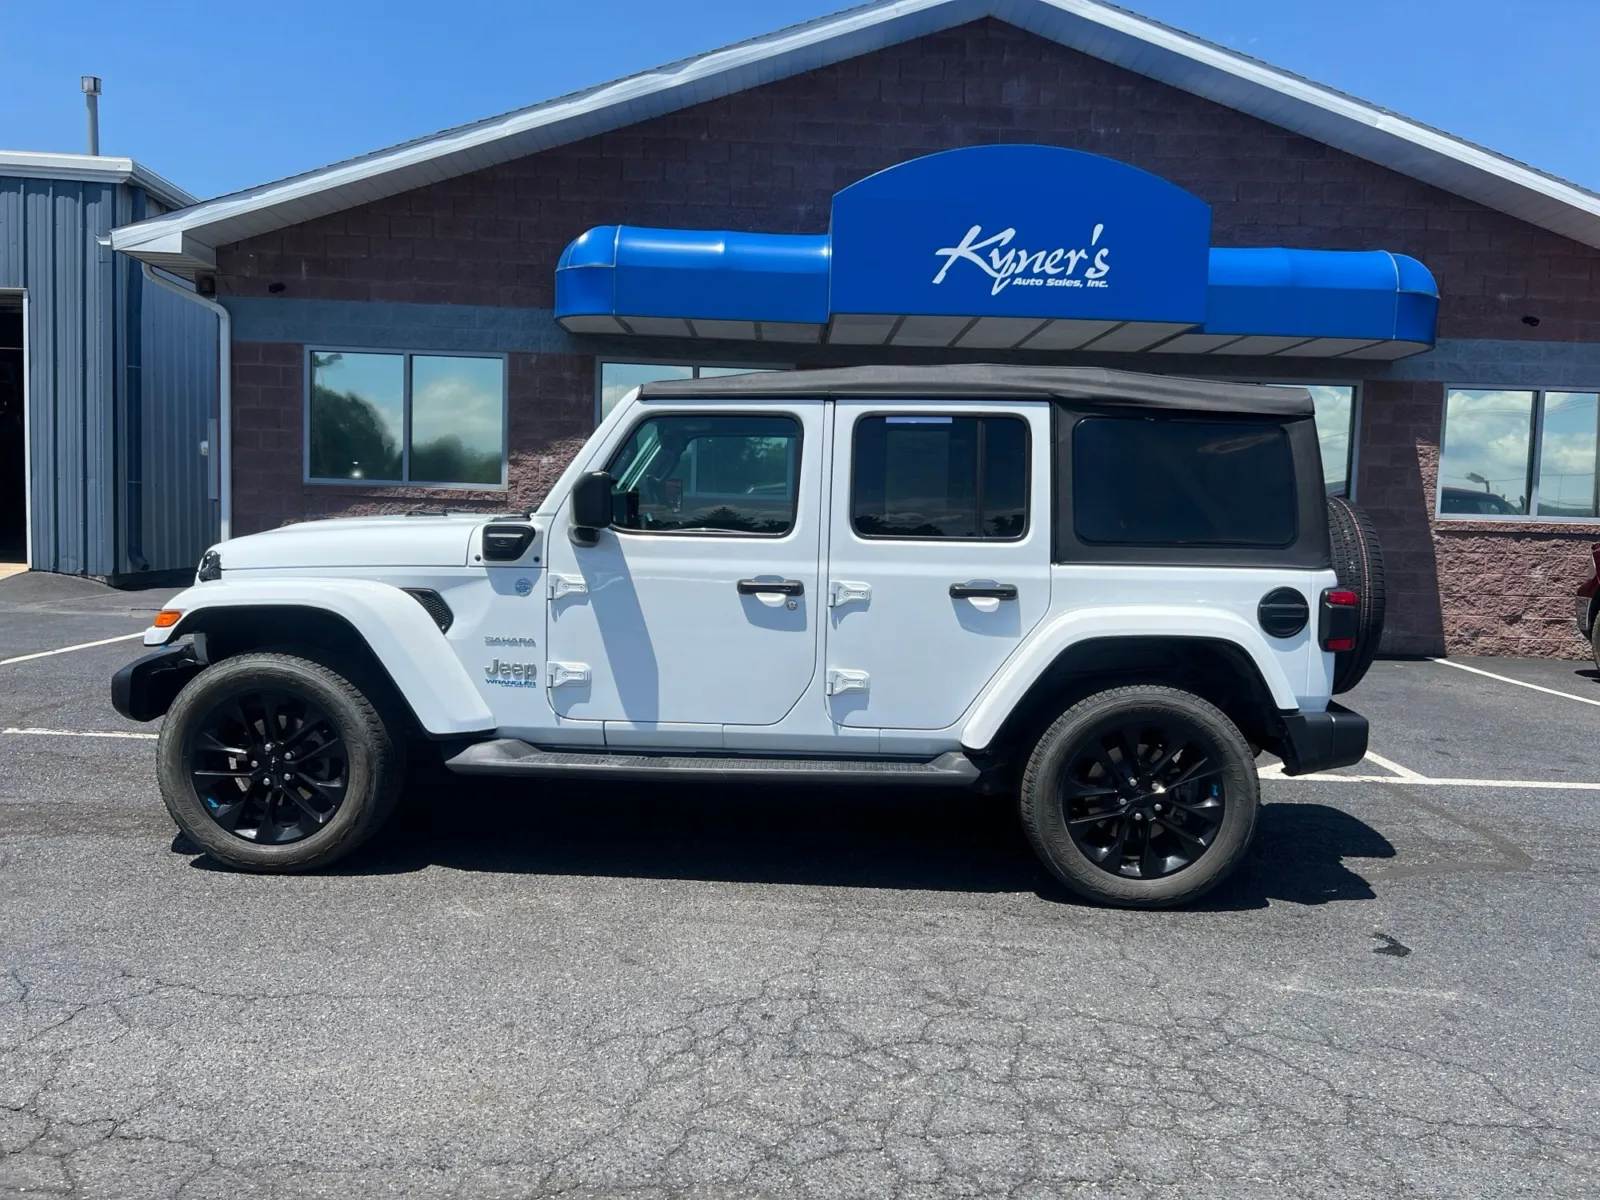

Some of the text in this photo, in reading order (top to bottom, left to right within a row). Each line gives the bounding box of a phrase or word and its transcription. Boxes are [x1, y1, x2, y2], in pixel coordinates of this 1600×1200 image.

[932, 223, 1110, 296] Kyner's
[1011, 276, 1109, 289] Auto Sales, Inc.
[484, 636, 536, 646] SAHARA
[484, 657, 538, 681] Jeep
[485, 679, 537, 687] WRANGLER
